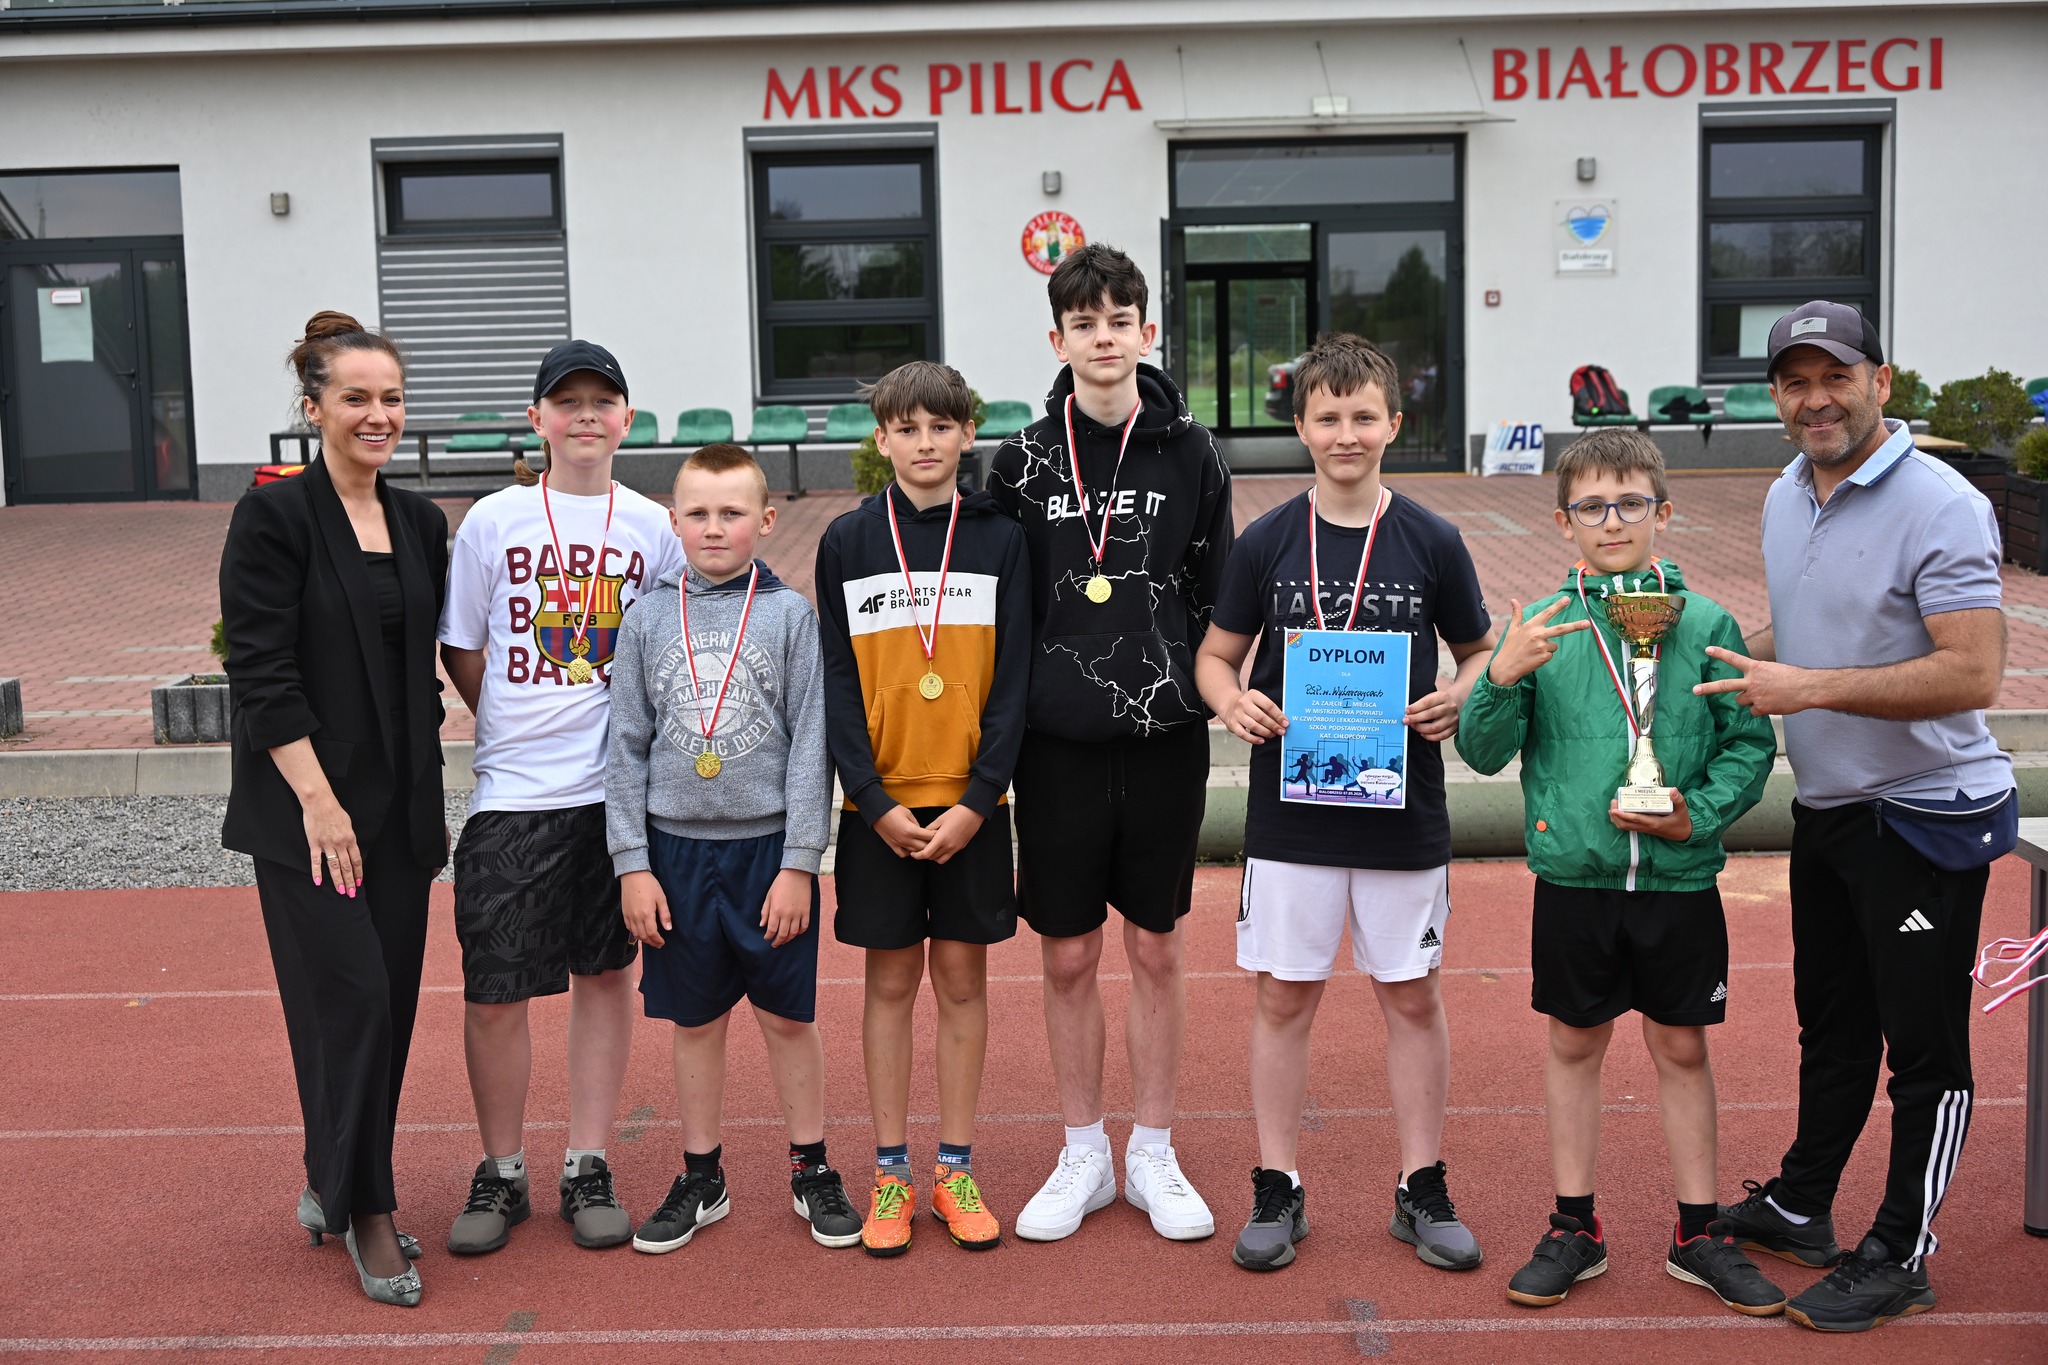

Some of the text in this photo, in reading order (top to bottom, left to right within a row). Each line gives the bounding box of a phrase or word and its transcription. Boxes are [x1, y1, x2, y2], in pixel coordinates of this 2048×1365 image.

[1493, 37, 1943, 100] BIAŁOBRZEGI
[763, 58, 1143, 119] MKS PILICA
[1028, 212, 1076, 232] PILICA
[1500, 462, 1535, 471] ACTION
[1145, 491, 1166, 516] IT
[890, 587, 972, 599] SPRTSWEAR
[858, 593, 886, 614] 4F
[890, 597, 930, 609] BRAND
[563, 614, 597, 626] FCB
[1309, 648, 1385, 664] DYPLOM
[1336, 717, 1398, 725] LEKKOATLETYCZNYM
[665, 717, 728, 756] THLETIC
[1419, 939, 1441, 949] adidas
